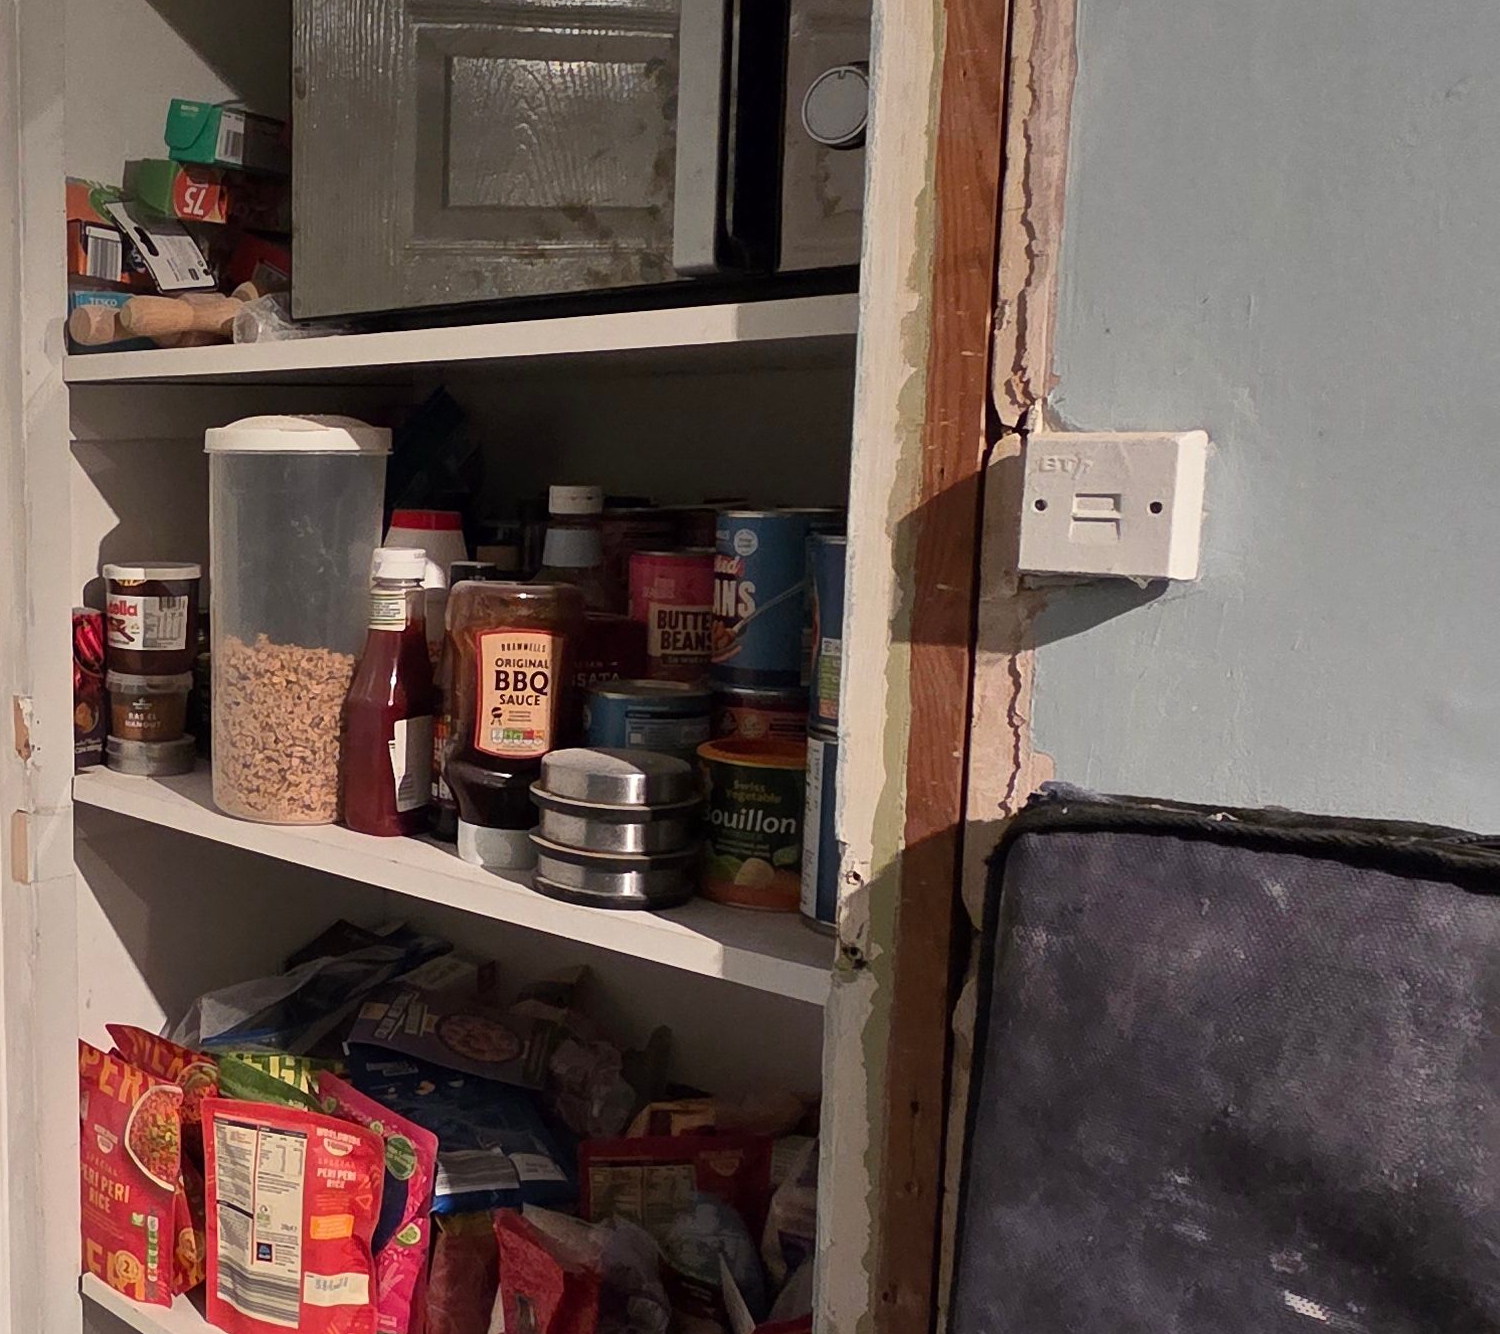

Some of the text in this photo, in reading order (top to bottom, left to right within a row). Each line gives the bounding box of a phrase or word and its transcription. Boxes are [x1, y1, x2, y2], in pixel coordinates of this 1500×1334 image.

[183, 187, 206, 215] 75
[657, 610, 712, 631] BUTTE
[495, 657, 549, 669] ORIGINAL
[494, 669, 549, 696] BBQ
[499, 693, 540, 706] SAUCE
